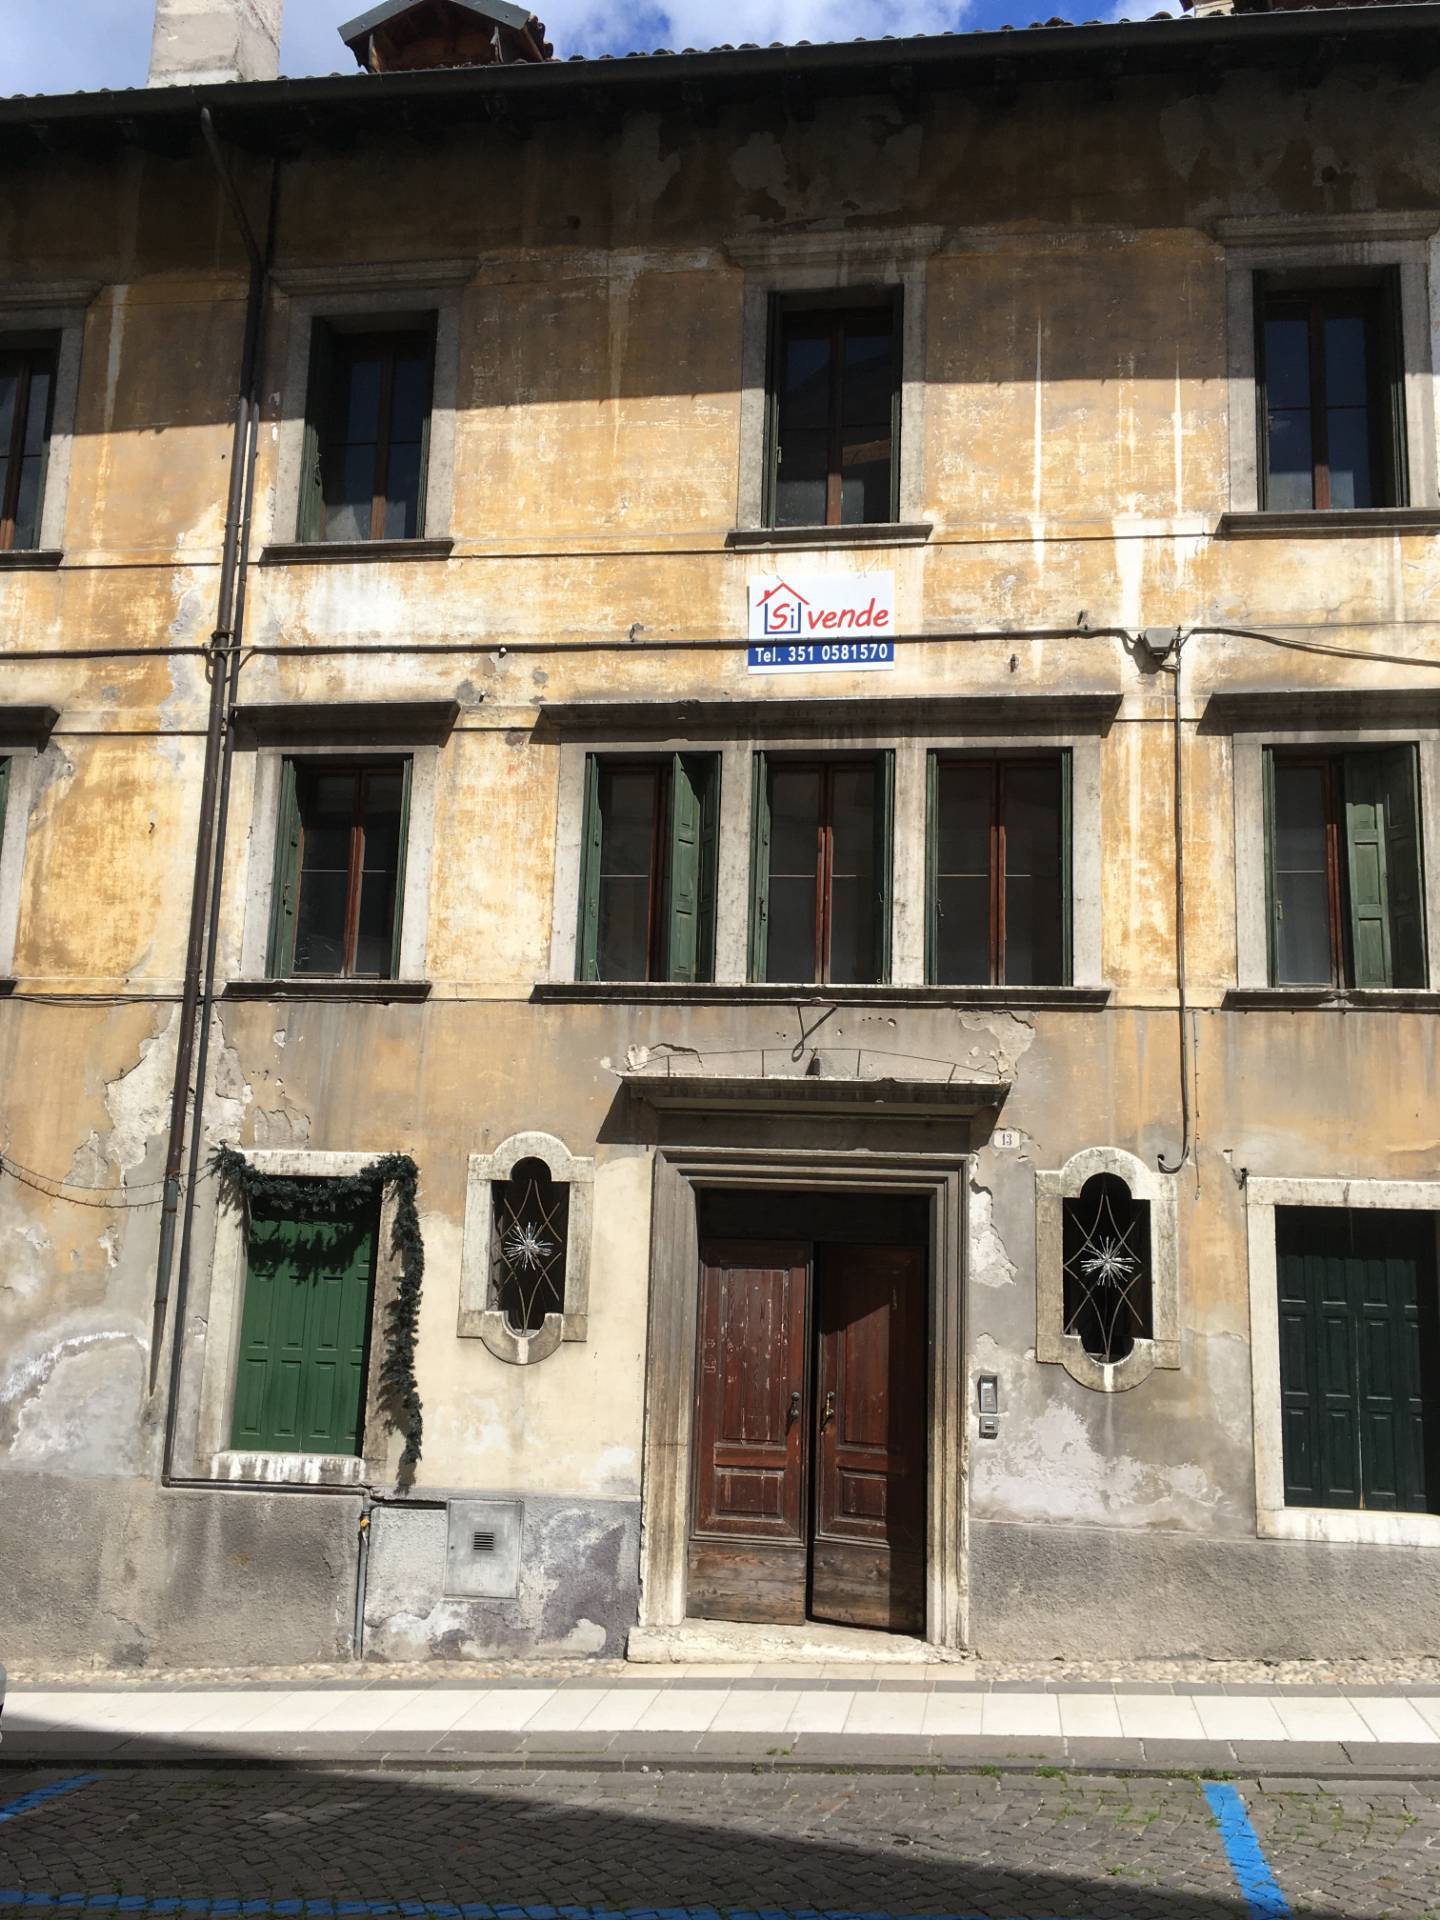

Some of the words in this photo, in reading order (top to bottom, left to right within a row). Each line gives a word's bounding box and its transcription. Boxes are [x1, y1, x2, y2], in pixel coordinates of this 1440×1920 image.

[769, 603, 795, 630] Si
[807, 597, 889, 629] vende
[755, 647, 782, 662] Tel.
[788, 645, 815, 661] 351
[821, 643, 888, 660] 0581570
[1002, 1133, 1012, 1146] 13
